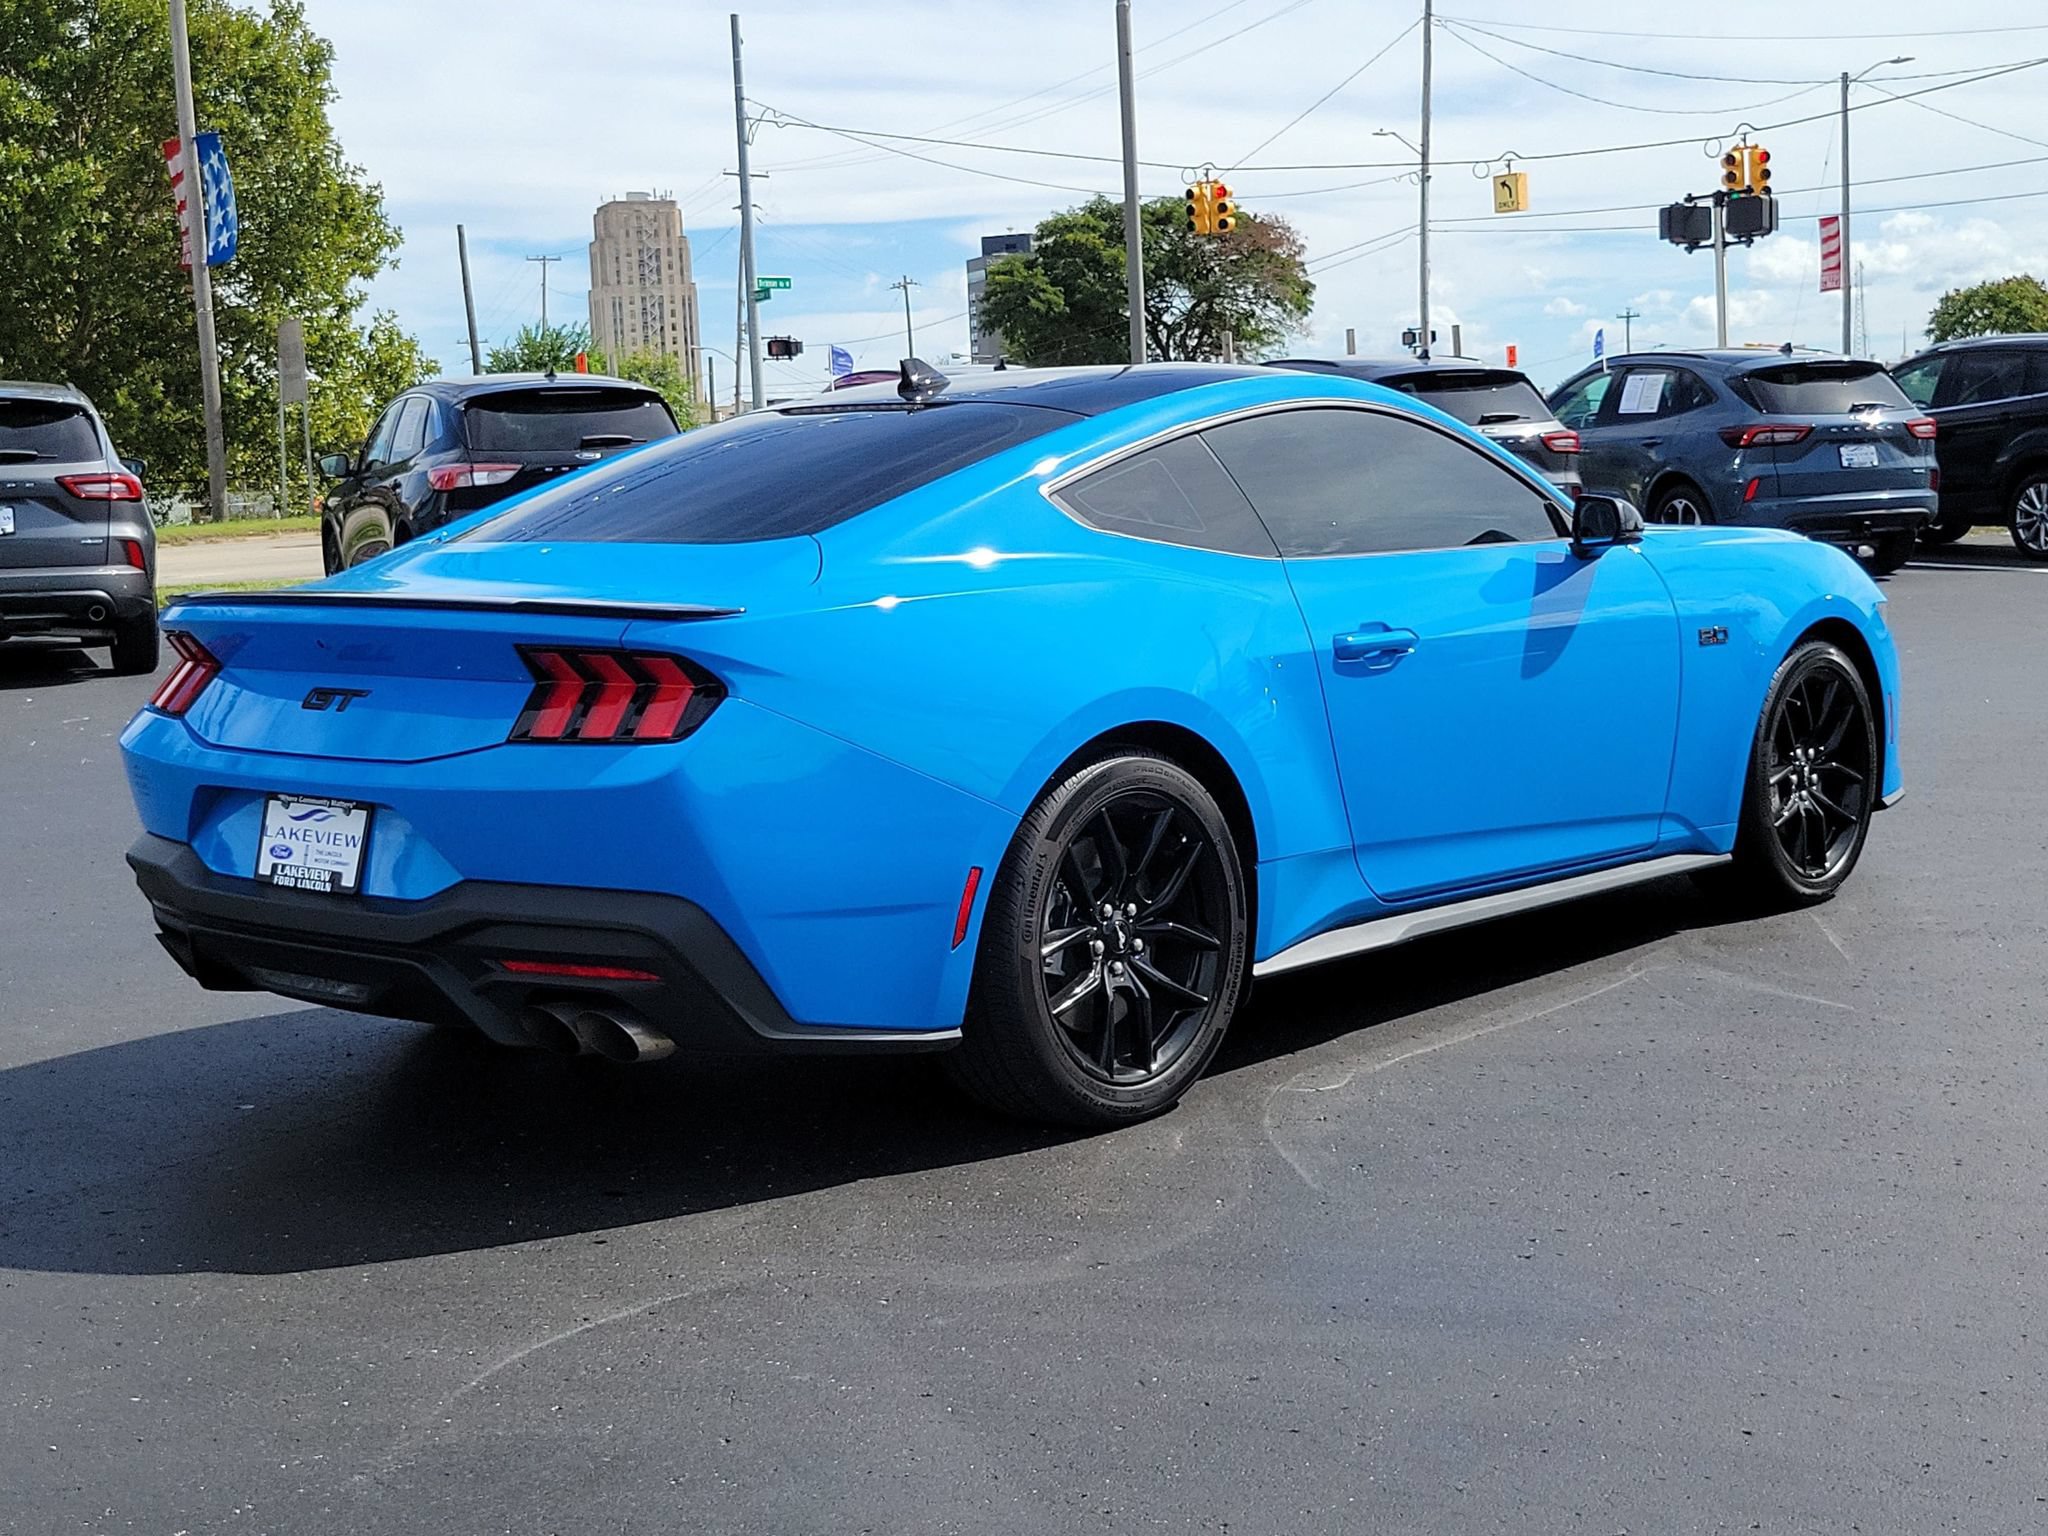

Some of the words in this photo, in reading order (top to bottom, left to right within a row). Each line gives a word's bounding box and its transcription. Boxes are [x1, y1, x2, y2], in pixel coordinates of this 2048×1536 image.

[1498, 200, 1515, 209] ONLY
[301, 687, 374, 712] GT
[264, 825, 361, 848] LAKEVIEW
[277, 864, 332, 881] LAKEVIEW
[273, 875, 296, 887] FORD
[297, 879, 332, 893] LINCOLN
[1021, 861, 1045, 944] Continental
